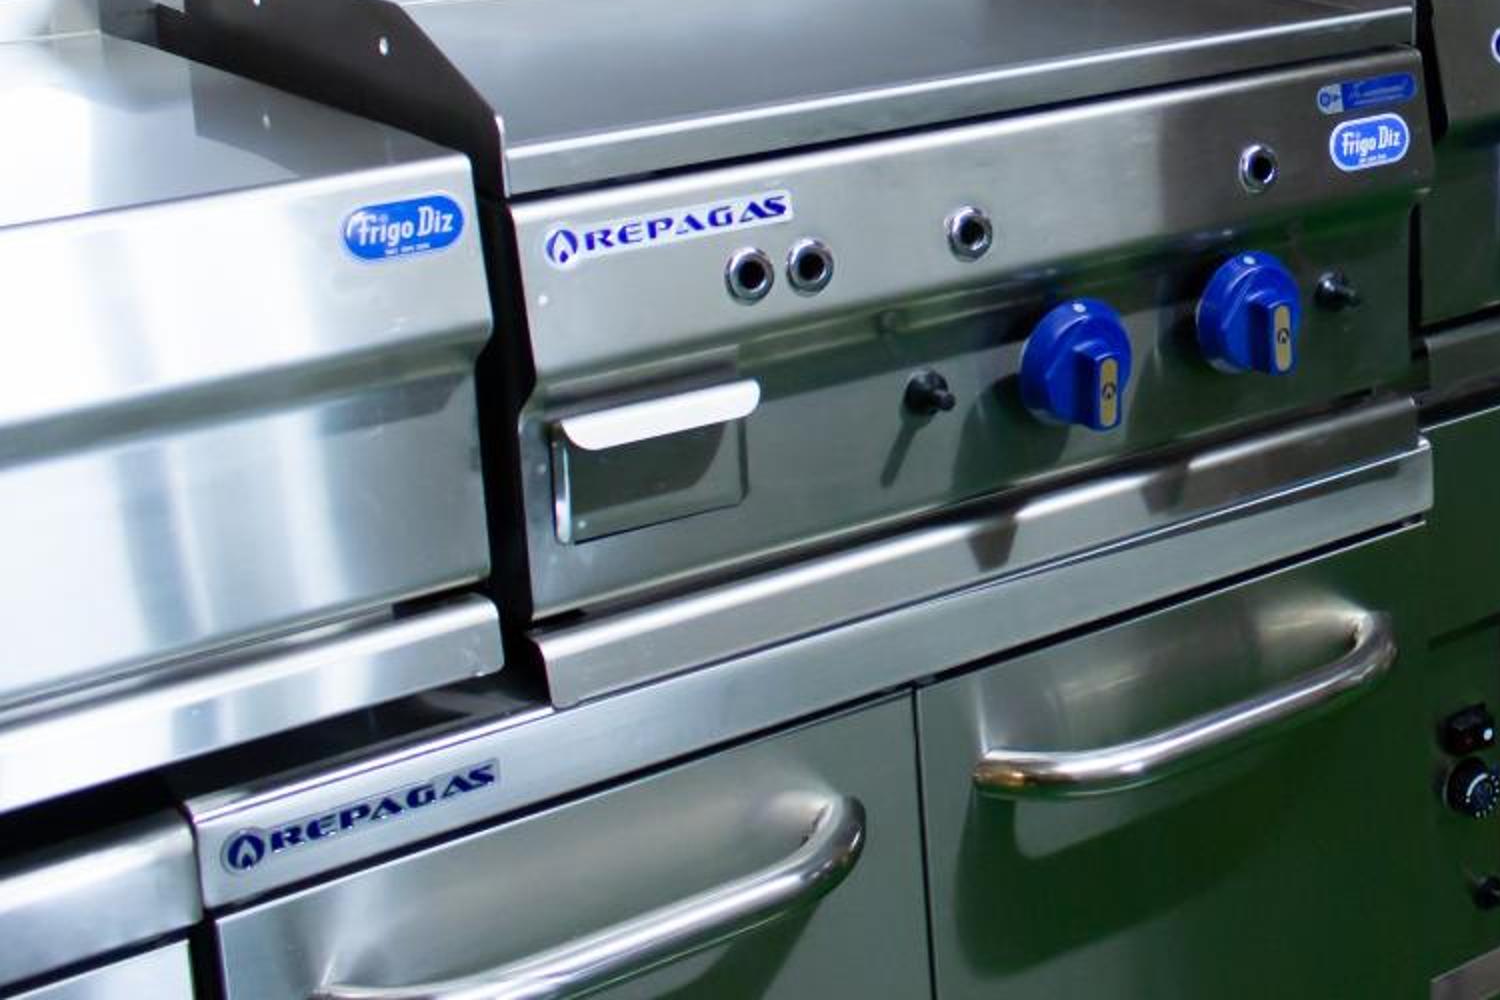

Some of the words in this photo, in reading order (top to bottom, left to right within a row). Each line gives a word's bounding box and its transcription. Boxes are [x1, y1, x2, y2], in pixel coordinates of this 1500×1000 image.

[1342, 131, 1376, 156] Frigo
[1378, 125, 1401, 149] Diz
[357, 212, 415, 248] Frigo
[417, 205, 454, 237] Diz
[584, 195, 787, 251] REPAGAS
[271, 763, 495, 852] REPAGAS
